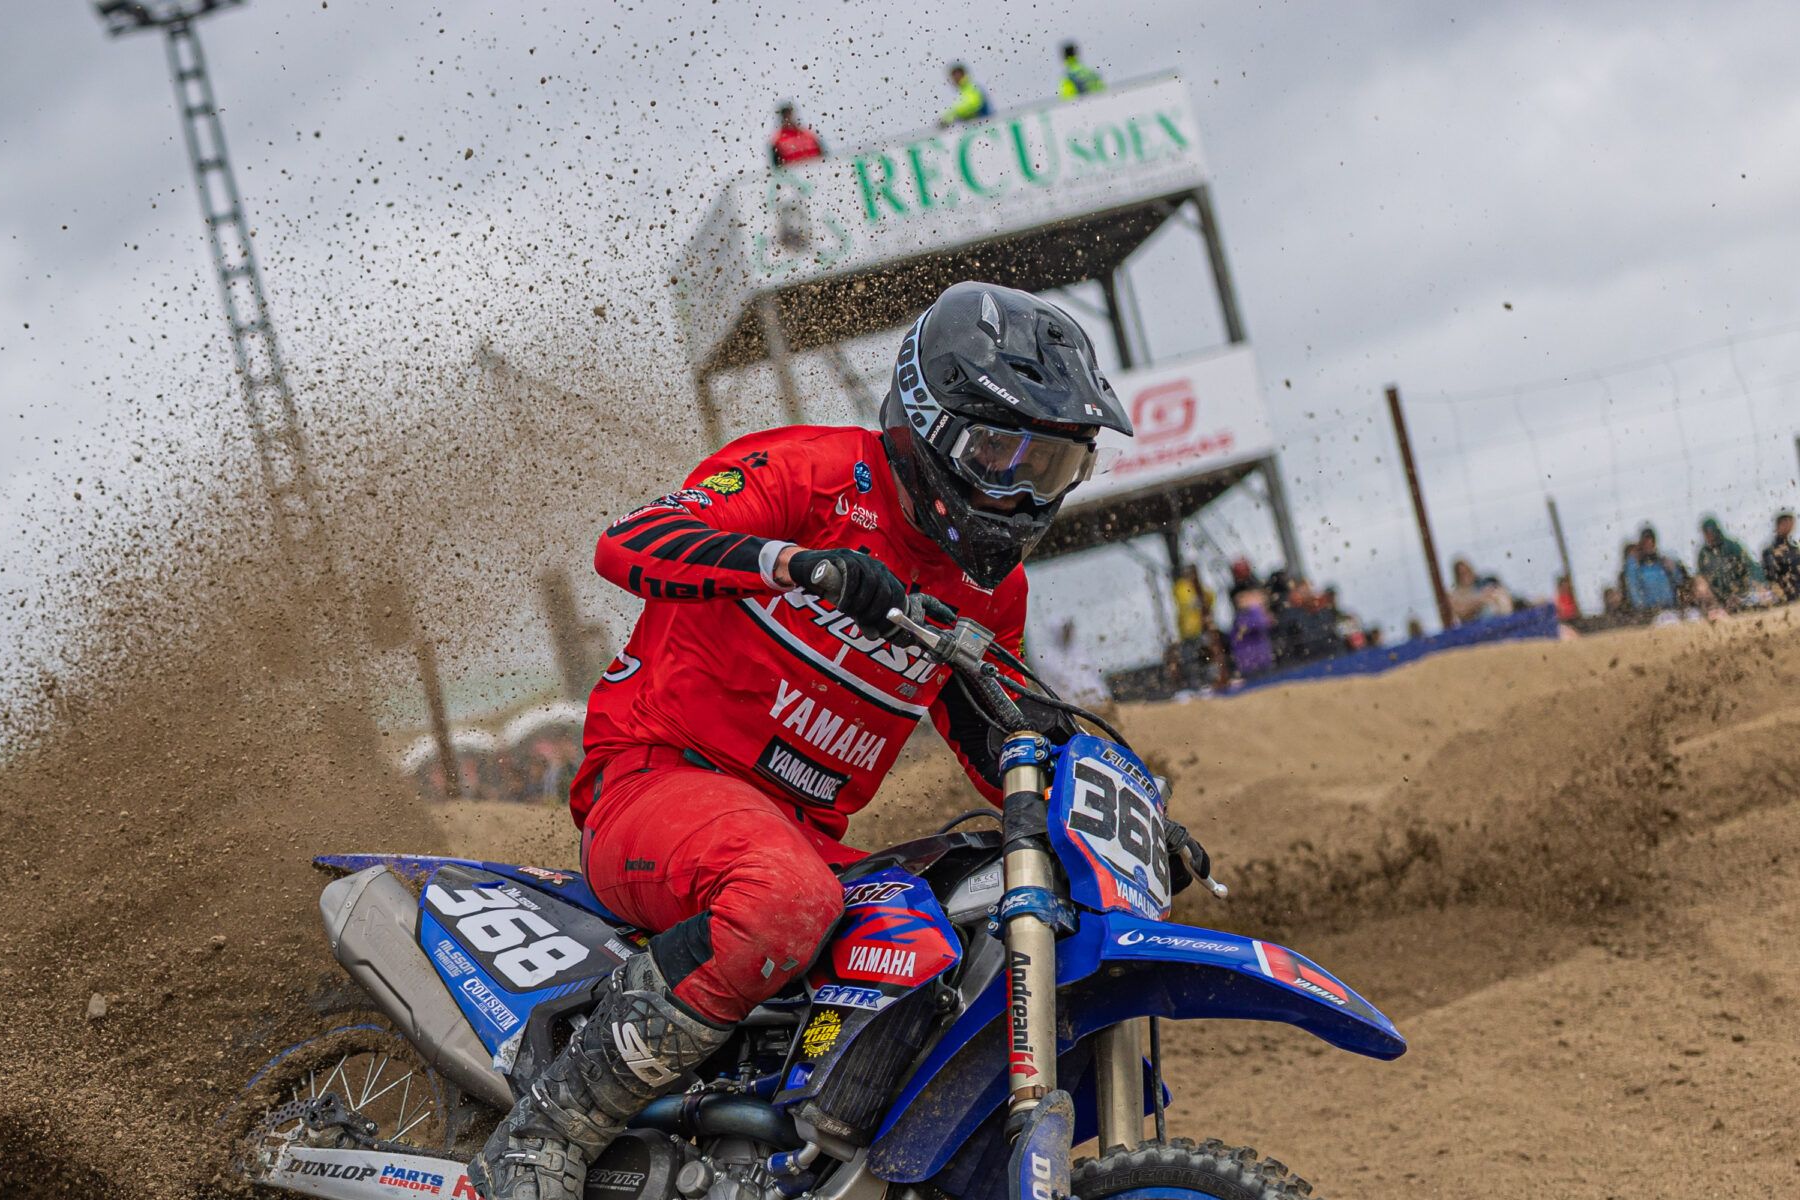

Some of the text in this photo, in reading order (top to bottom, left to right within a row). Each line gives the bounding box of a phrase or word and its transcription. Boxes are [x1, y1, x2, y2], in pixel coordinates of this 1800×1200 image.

[769, 678, 887, 771] YAMAHA
[768, 745, 843, 801] YAMALUBE
[426, 884, 590, 988] 368
[847, 945, 917, 978] YAMAHA
[462, 977, 519, 1031] COLISEUM
[813, 984, 883, 1009] GYTR
[1010, 950, 1033, 1054] Andreani
[1293, 976, 1347, 1006] YAMAHA
[803, 1024, 841, 1038] METAL
[804, 1031, 838, 1044] LUBE
[284, 1158, 378, 1182] DUNLOP
[381, 1164, 445, 1187] PARTS
[378, 1176, 441, 1195] EUROPE
